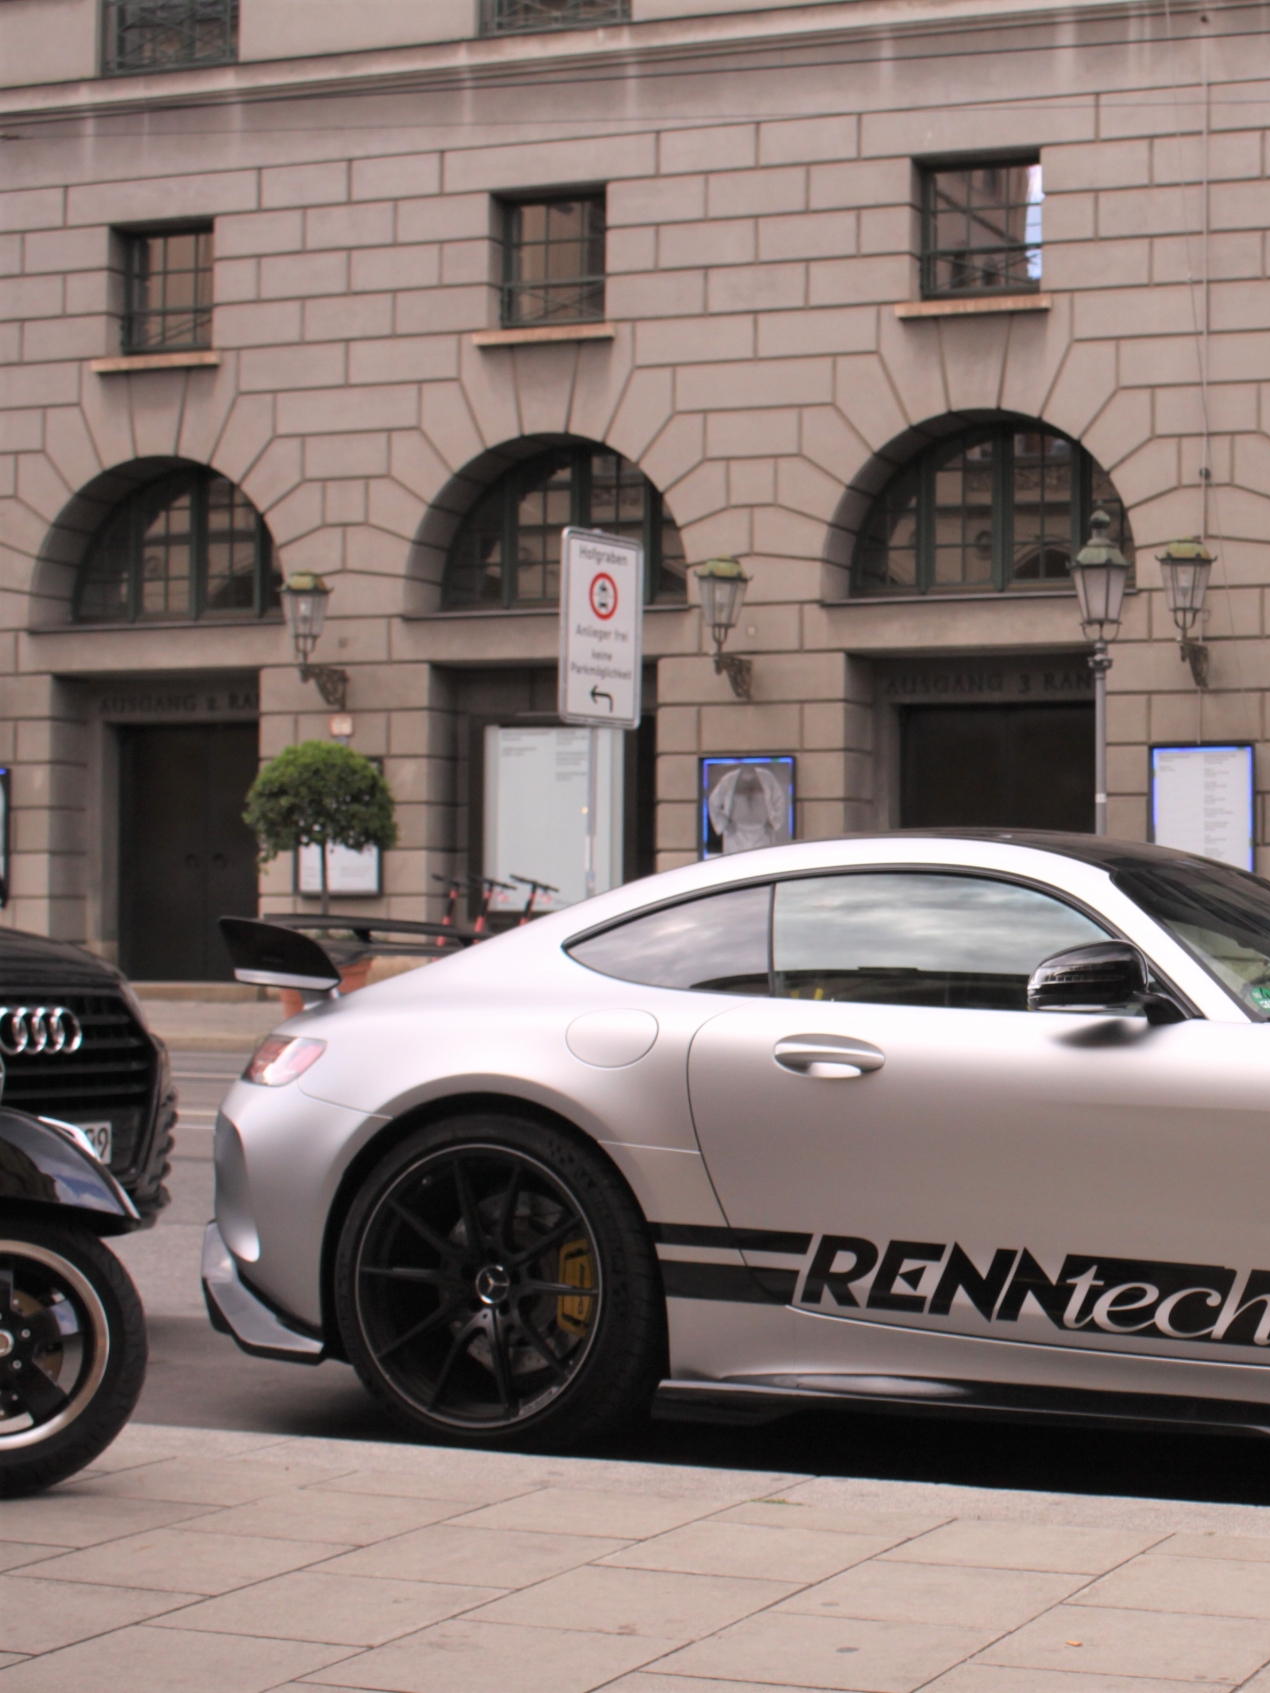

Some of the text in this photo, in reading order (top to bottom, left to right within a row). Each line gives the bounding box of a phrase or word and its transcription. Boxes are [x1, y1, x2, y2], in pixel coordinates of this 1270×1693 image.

[579, 545, 628, 567] Hofgraben
[576, 623, 629, 642] Anlieger frei
[592, 650, 612, 662] keine
[571, 661, 632, 680] Parkmöglichkeit
[886, 674, 1003, 695] AUSGANG
[100, 694, 197, 714] AUSGANG
